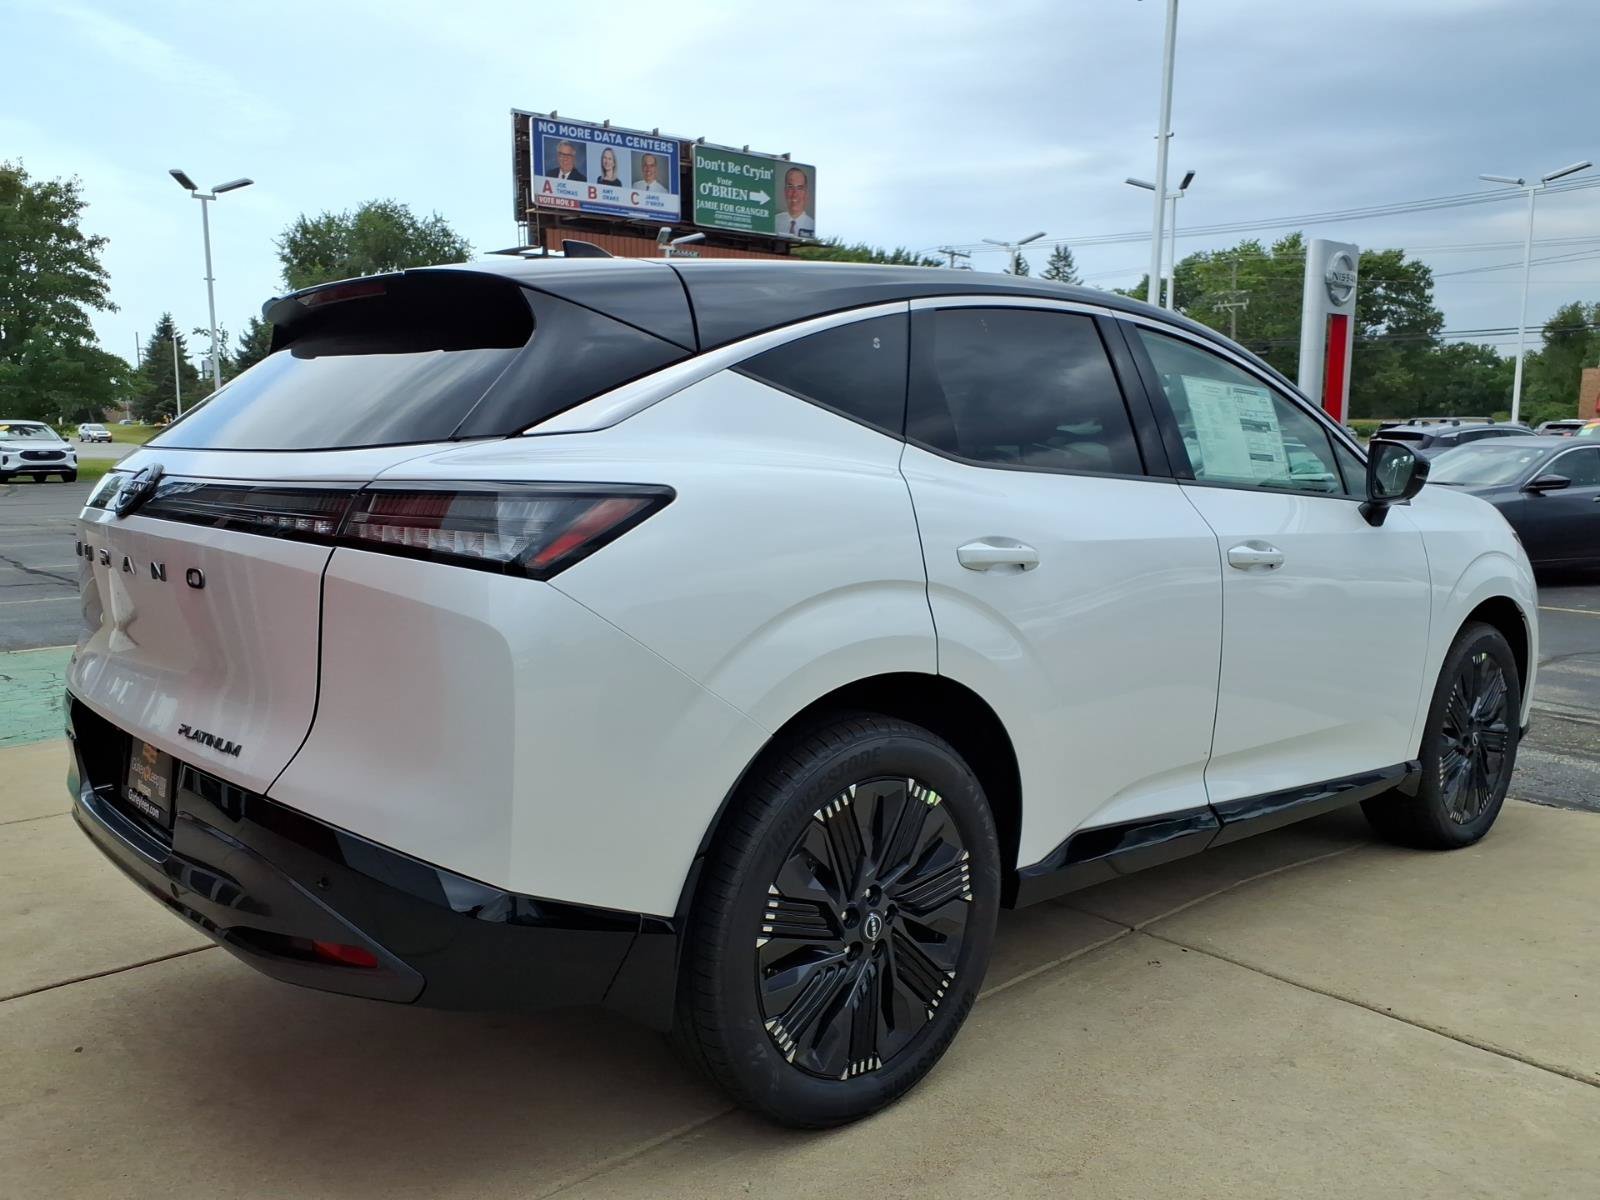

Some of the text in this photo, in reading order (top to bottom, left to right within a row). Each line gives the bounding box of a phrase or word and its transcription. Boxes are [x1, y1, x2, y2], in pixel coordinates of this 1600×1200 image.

[538, 121, 674, 153] NO MORE DATA CENTERS
[696, 156, 774, 180] Don't Be Cryin'
[542, 179, 553, 194] A
[717, 177, 733, 186] Vote
[587, 185, 597, 199] B
[631, 191, 640, 205] C
[700, 182, 749, 200] O'BRIEN
[539, 196, 555, 205] VOTE
[696, 200, 720, 211] JAMIE
[720, 202, 735, 213] FOR
[735, 205, 770, 218] GRANGER
[177, 723, 243, 758] PLATINUM
